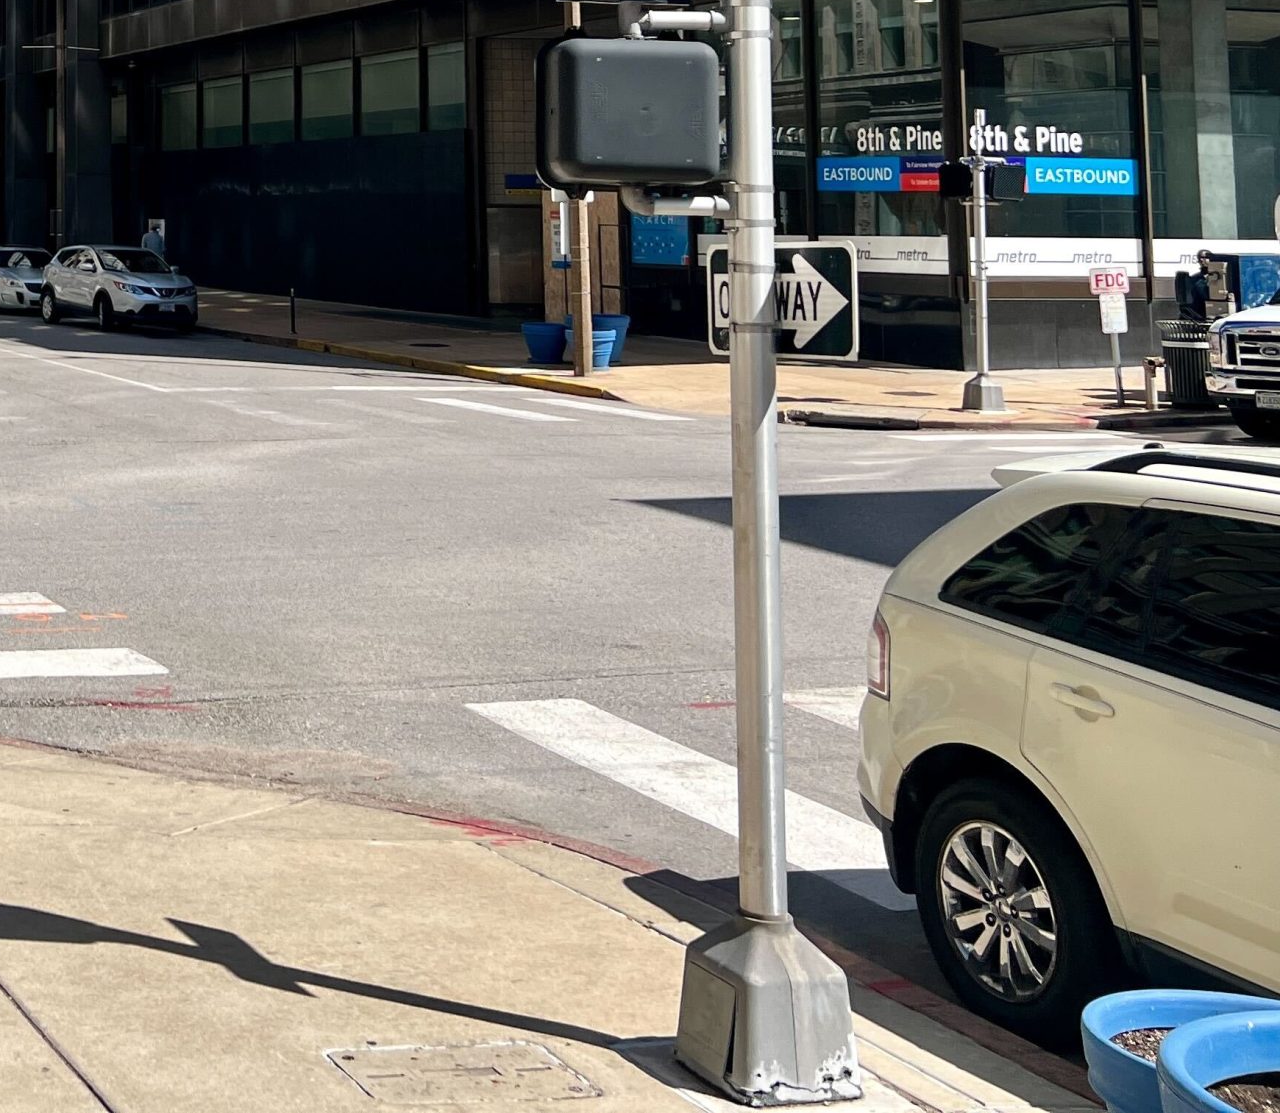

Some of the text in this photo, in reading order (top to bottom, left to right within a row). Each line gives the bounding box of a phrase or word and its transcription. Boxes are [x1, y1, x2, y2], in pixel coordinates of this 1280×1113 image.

[856, 125, 942, 151] 8th & Pine
[969, 125, 1083, 153] 8th & Pine
[823, 167, 893, 182] EASTBOUND
[1035, 168, 1130, 185] EASTBOUND
[857, 247, 871, 261] tro
[896, 249, 929, 262] metro
[996, 250, 1037, 264] metro
[1072, 250, 1113, 265] metro
[1094, 272, 1125, 289] FDC
[774, 281, 822, 321] WAY
